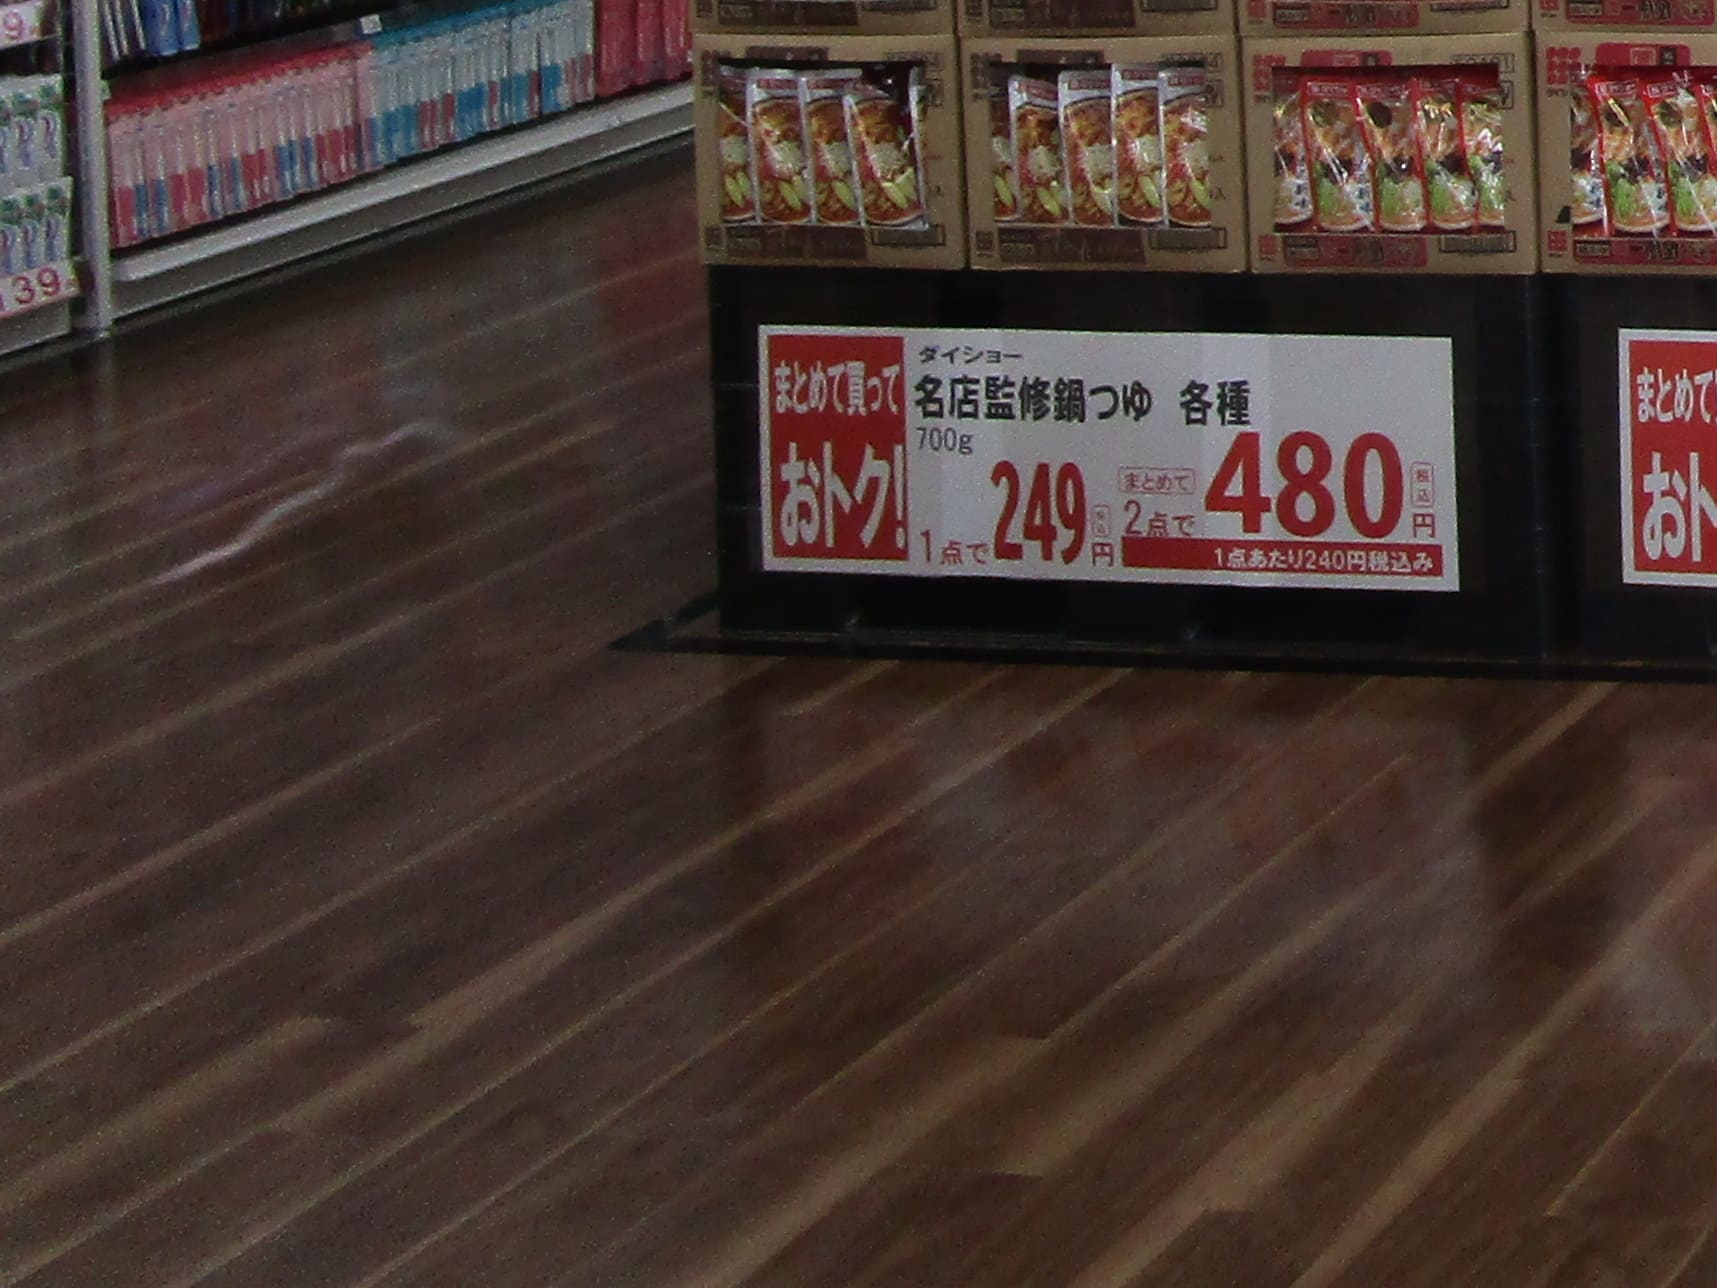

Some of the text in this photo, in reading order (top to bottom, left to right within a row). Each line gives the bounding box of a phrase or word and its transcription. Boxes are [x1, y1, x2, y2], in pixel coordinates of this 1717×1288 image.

[917, 344, 1023, 365] ダイショー
[773, 359, 900, 417] まとめて買って
[913, 373, 1252, 426] 名店監修鍋つゆ 各種
[916, 427, 974, 456] 700g
[780, 440, 909, 551] おトク!
[1121, 470, 1193, 493] まとめて
[1124, 498, 1195, 538] 2点で
[1204, 429, 1404, 539] 480
[1411, 511, 1437, 538] 円
[920, 529, 990, 566] 1点で
[989, 459, 1088, 564] 249
[1091, 540, 1115, 567] 円
[1212, 544, 1435, 575] 1点あたり240円税込み
